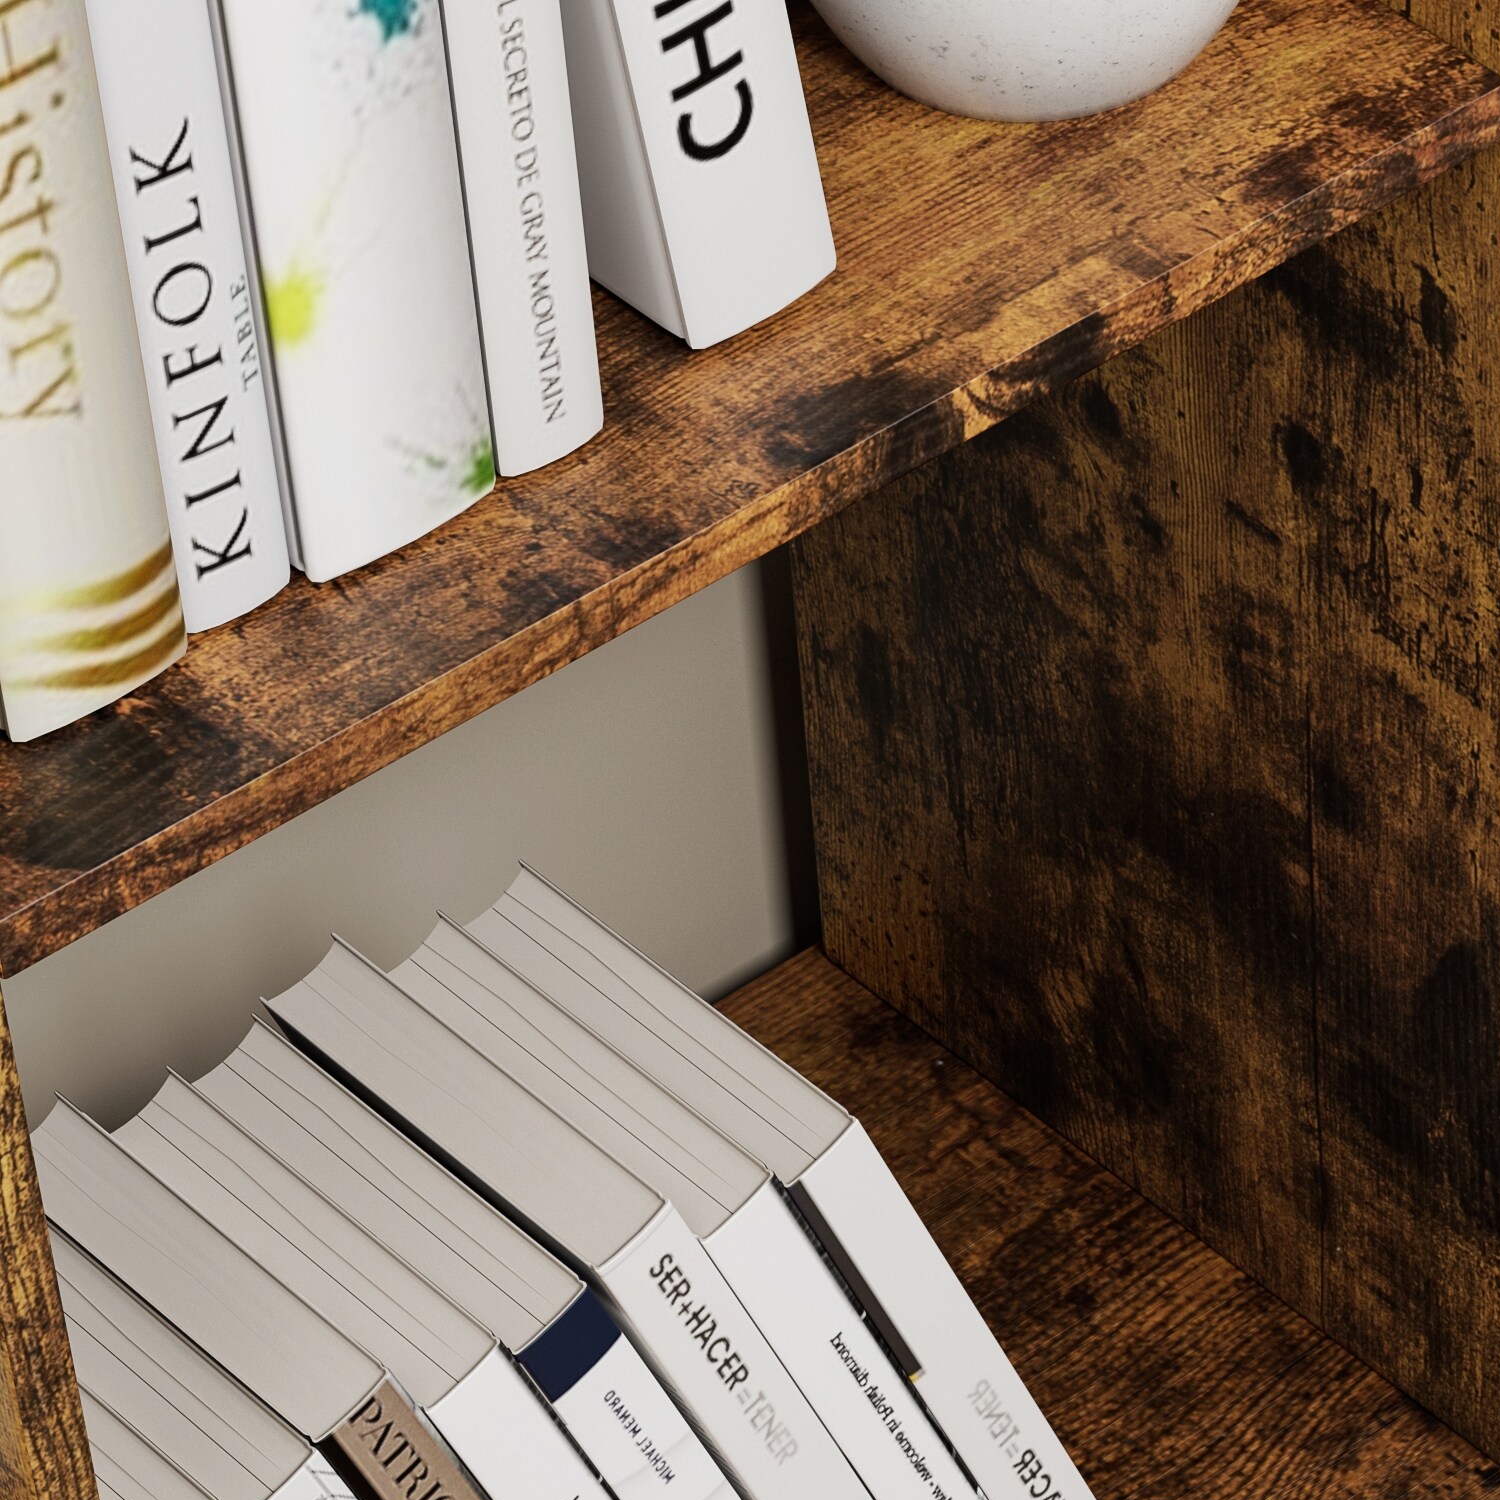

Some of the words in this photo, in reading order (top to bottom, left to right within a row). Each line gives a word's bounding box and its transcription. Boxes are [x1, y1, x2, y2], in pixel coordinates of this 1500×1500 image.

[500, 18, 535, 142] SECRETO
[515, 144, 540, 188] DE
[520, 191, 548, 262] GRAY
[130, 117, 252, 581] KINFOLK
[230, 274, 259, 392] TABLE
[528, 269, 566, 424] MOUNTAIN
